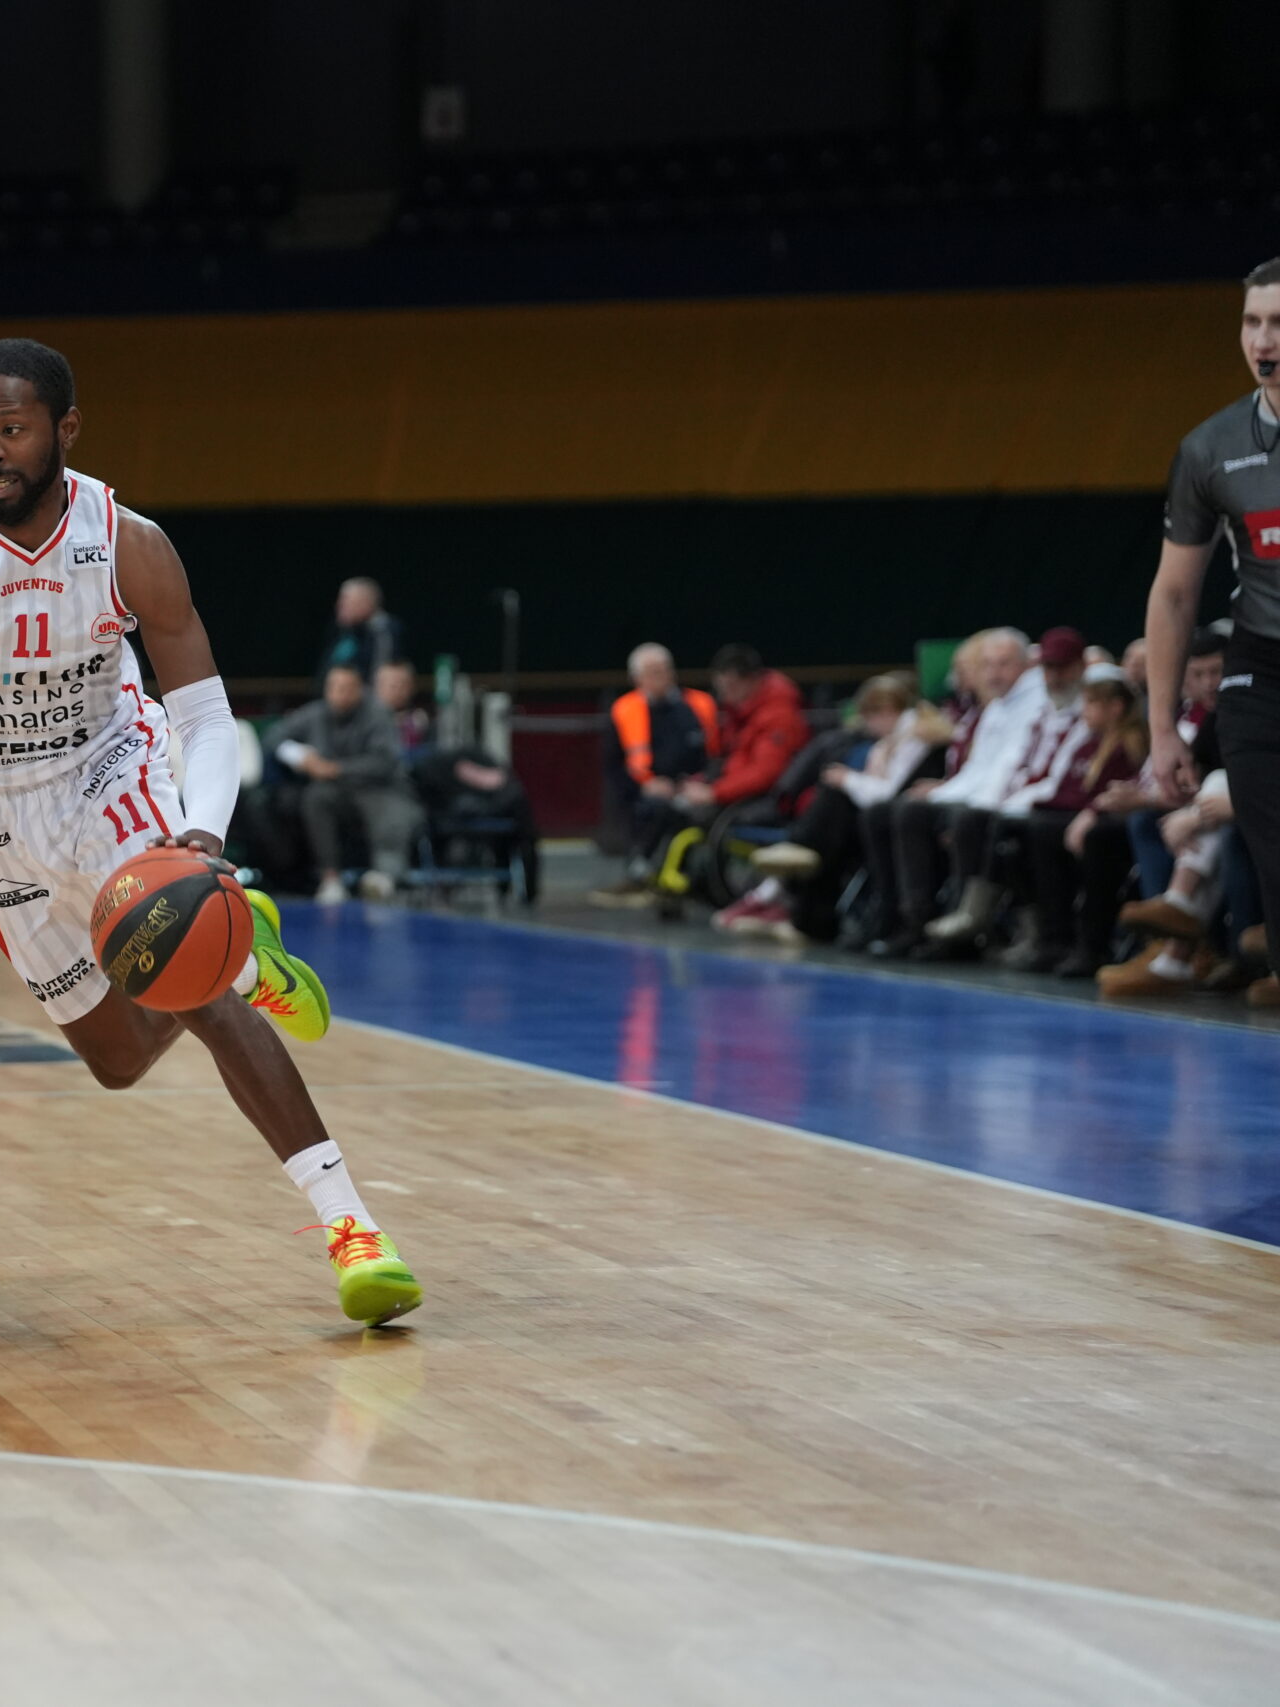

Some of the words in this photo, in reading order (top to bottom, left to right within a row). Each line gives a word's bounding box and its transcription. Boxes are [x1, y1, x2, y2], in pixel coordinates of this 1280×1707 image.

[73, 545, 100, 553] betsafe
[74, 552, 108, 564] LKL
[0, 577, 64, 597] JUVENTUS
[99, 621, 120, 633] um
[13, 613, 51, 658] 11
[102, 792, 150, 846] 11
[0, 891, 21, 900] UAB
[41, 957, 87, 991] UTENOS
